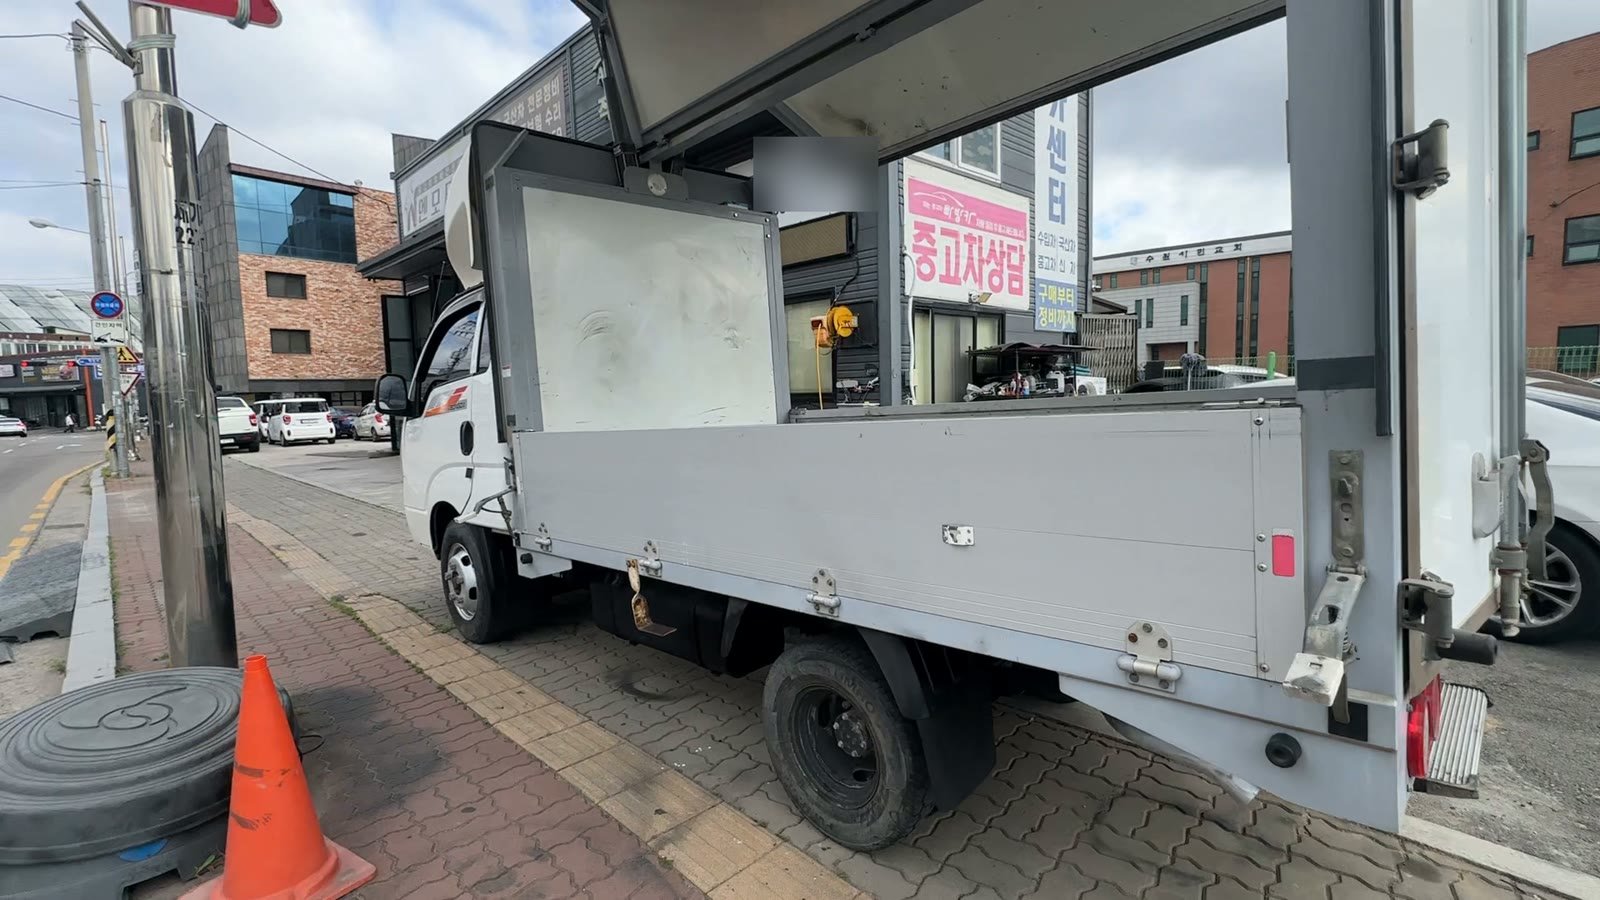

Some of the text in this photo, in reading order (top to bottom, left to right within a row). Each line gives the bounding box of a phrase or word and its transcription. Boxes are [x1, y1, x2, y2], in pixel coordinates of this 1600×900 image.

[545, 101, 561, 126] 수리
[911, 220, 1025, 296] 중고차상담
[1038, 254, 1056, 272] 중고차
[1039, 283, 1074, 307] 구매부터
[1039, 306, 1076, 330] 정비까지
